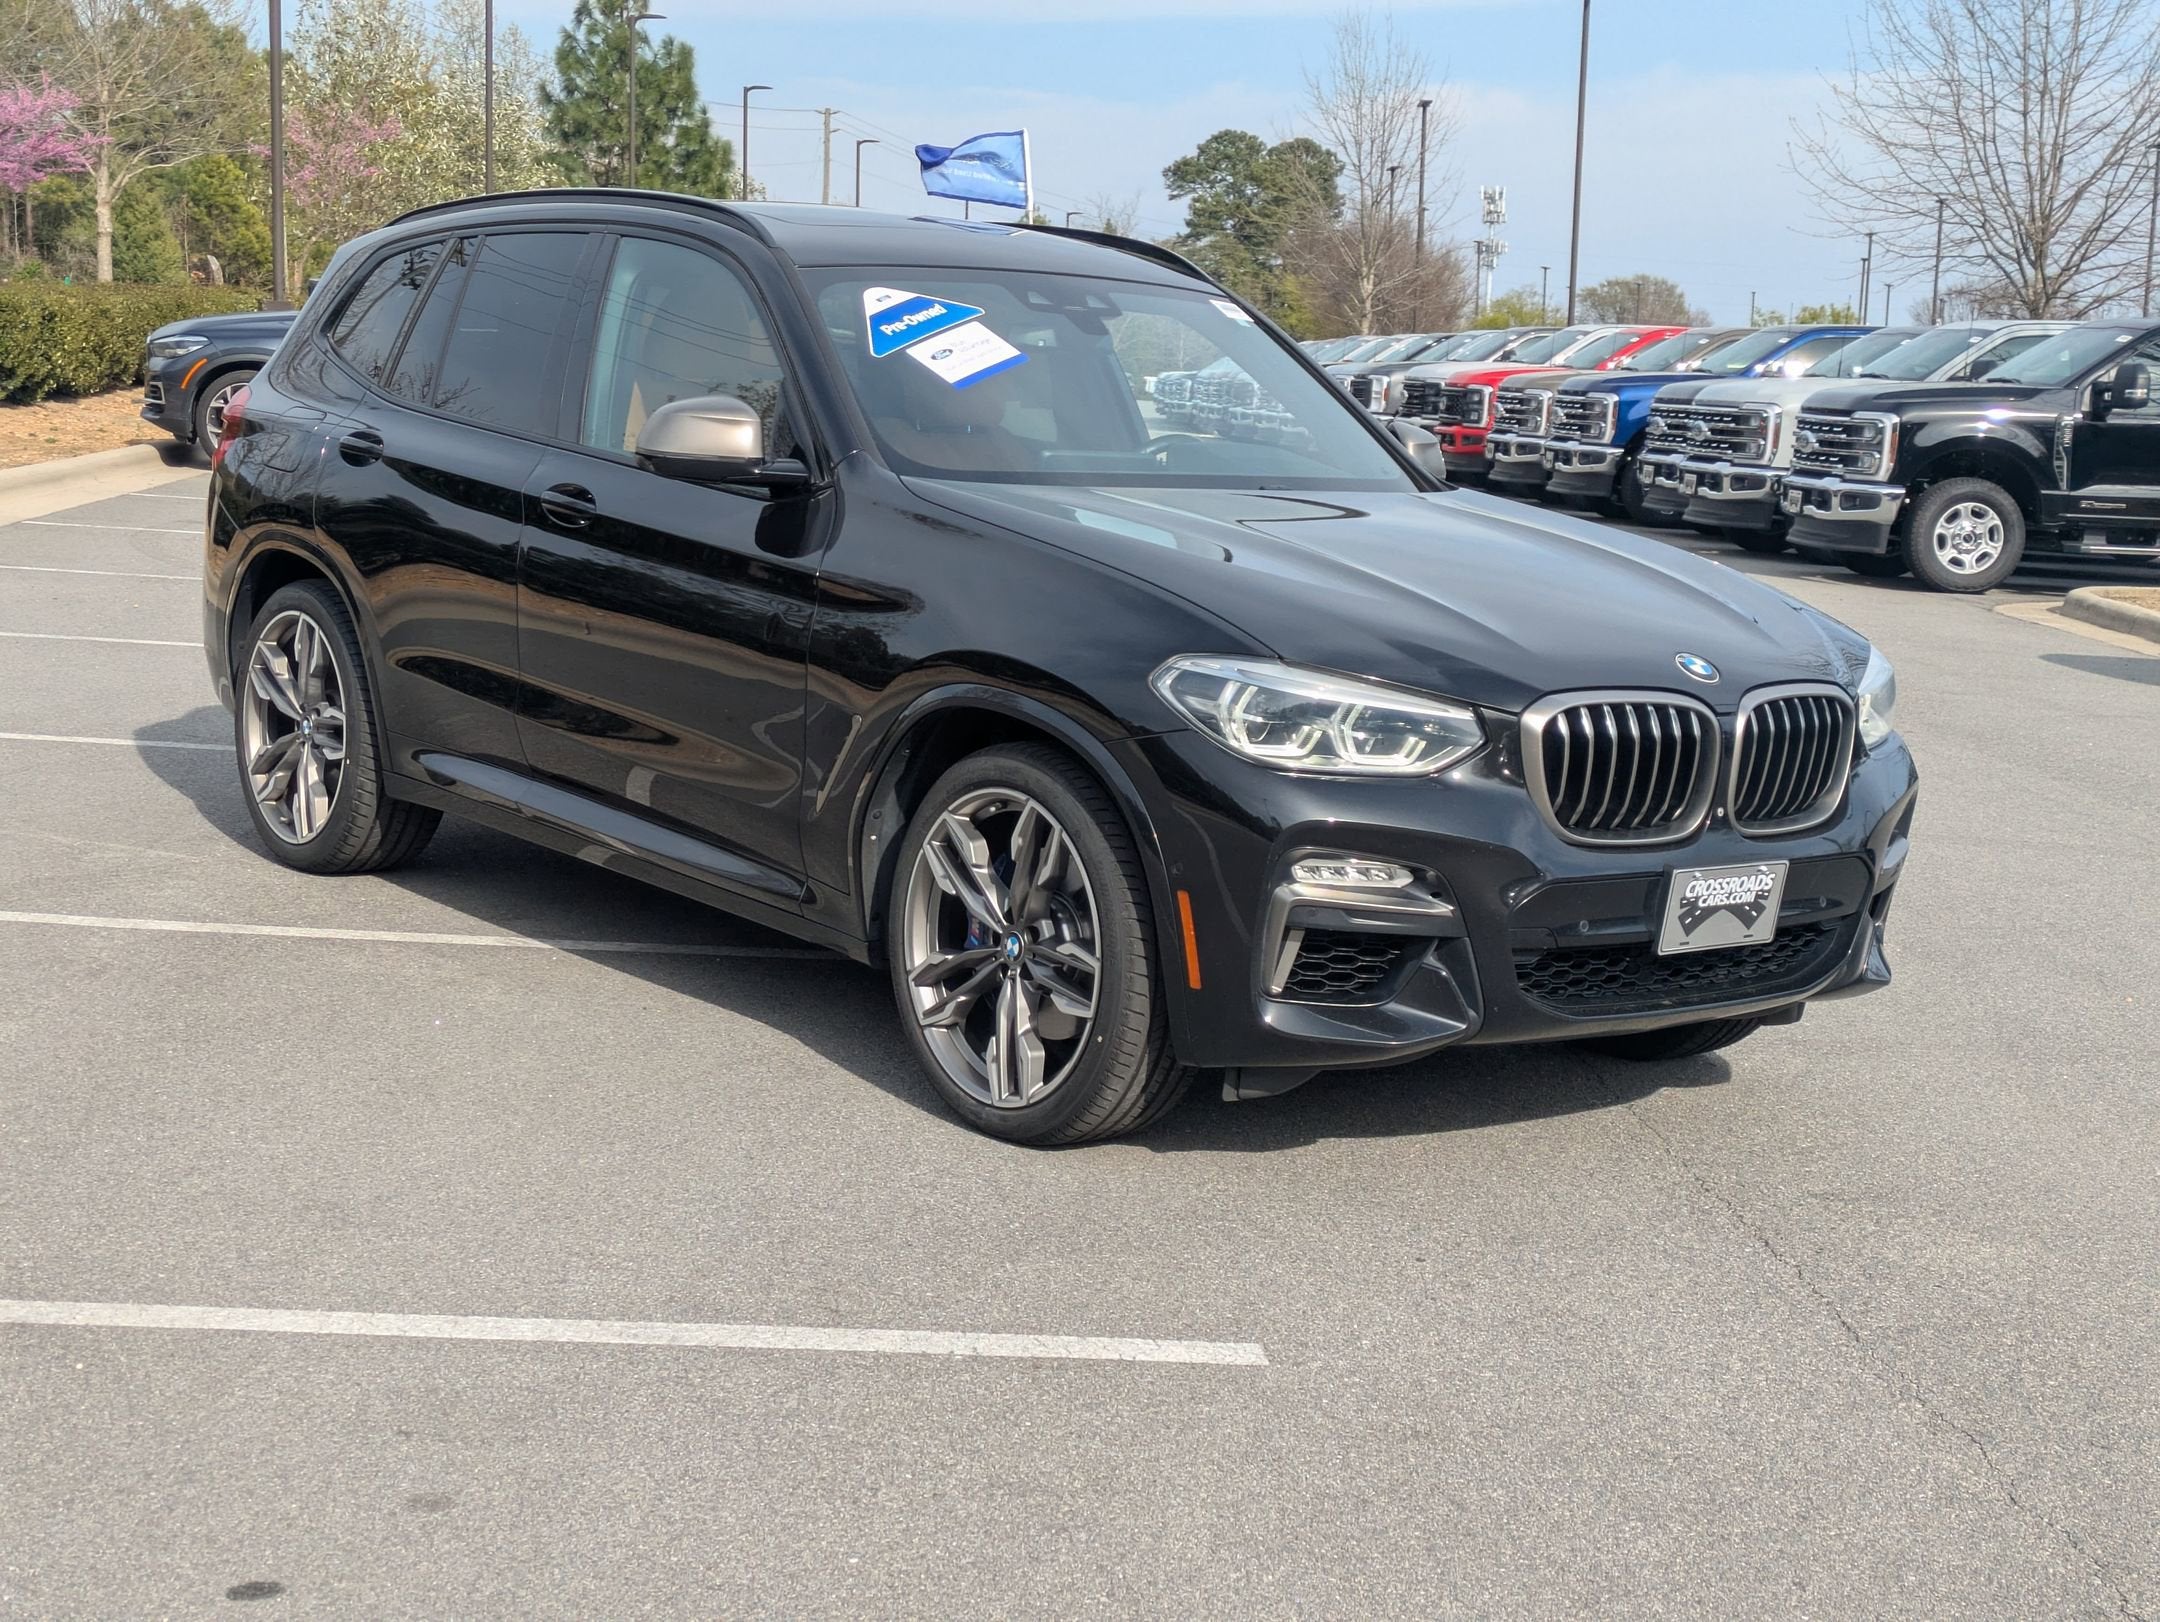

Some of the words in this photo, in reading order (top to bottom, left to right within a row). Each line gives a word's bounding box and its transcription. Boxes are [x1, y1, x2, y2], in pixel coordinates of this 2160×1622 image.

[879, 303, 948, 336] Pre-Owned
[1685, 873, 1776, 897] CROSSROADS
[1698, 891, 1757, 907] CARS.COM
